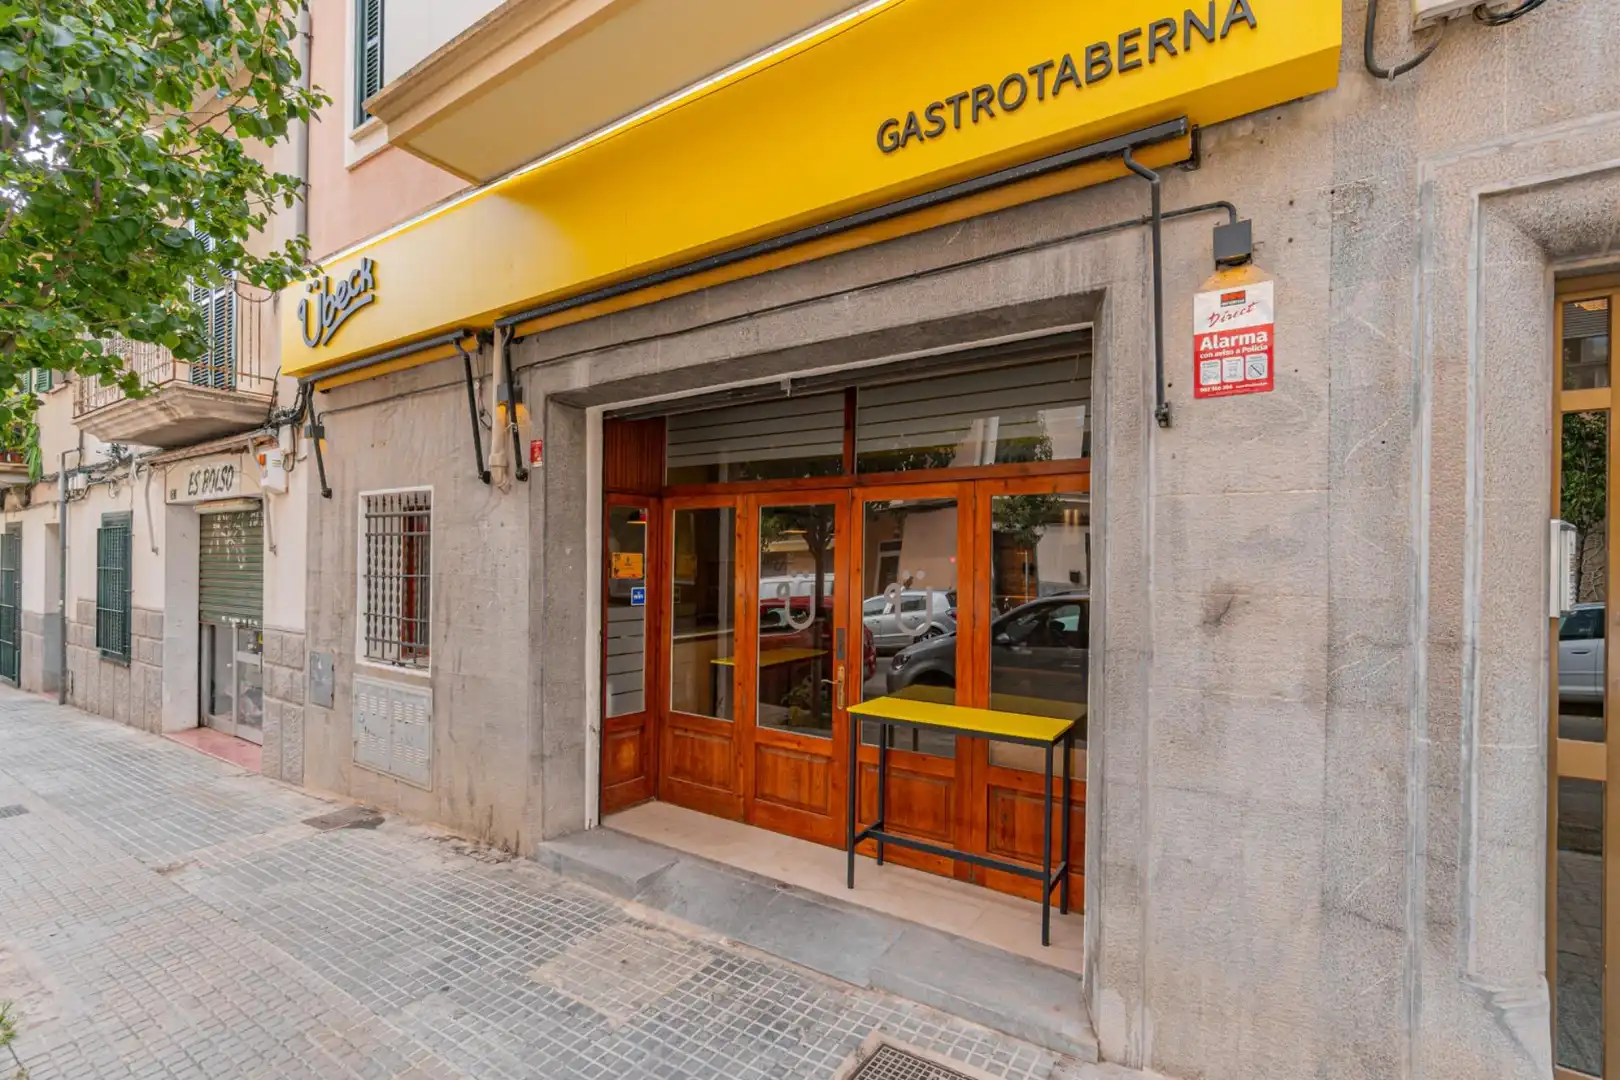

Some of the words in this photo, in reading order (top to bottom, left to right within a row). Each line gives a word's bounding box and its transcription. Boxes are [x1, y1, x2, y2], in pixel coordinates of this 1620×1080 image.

[876, 0, 1257, 154] GASTROTABERNA
[297, 256, 375, 348] Übeck
[1200, 331, 1269, 351] Alarma
[1200, 351, 1213, 359] con
[188, 470, 201, 496] ES
[202, 464, 235, 494] BOLSO
